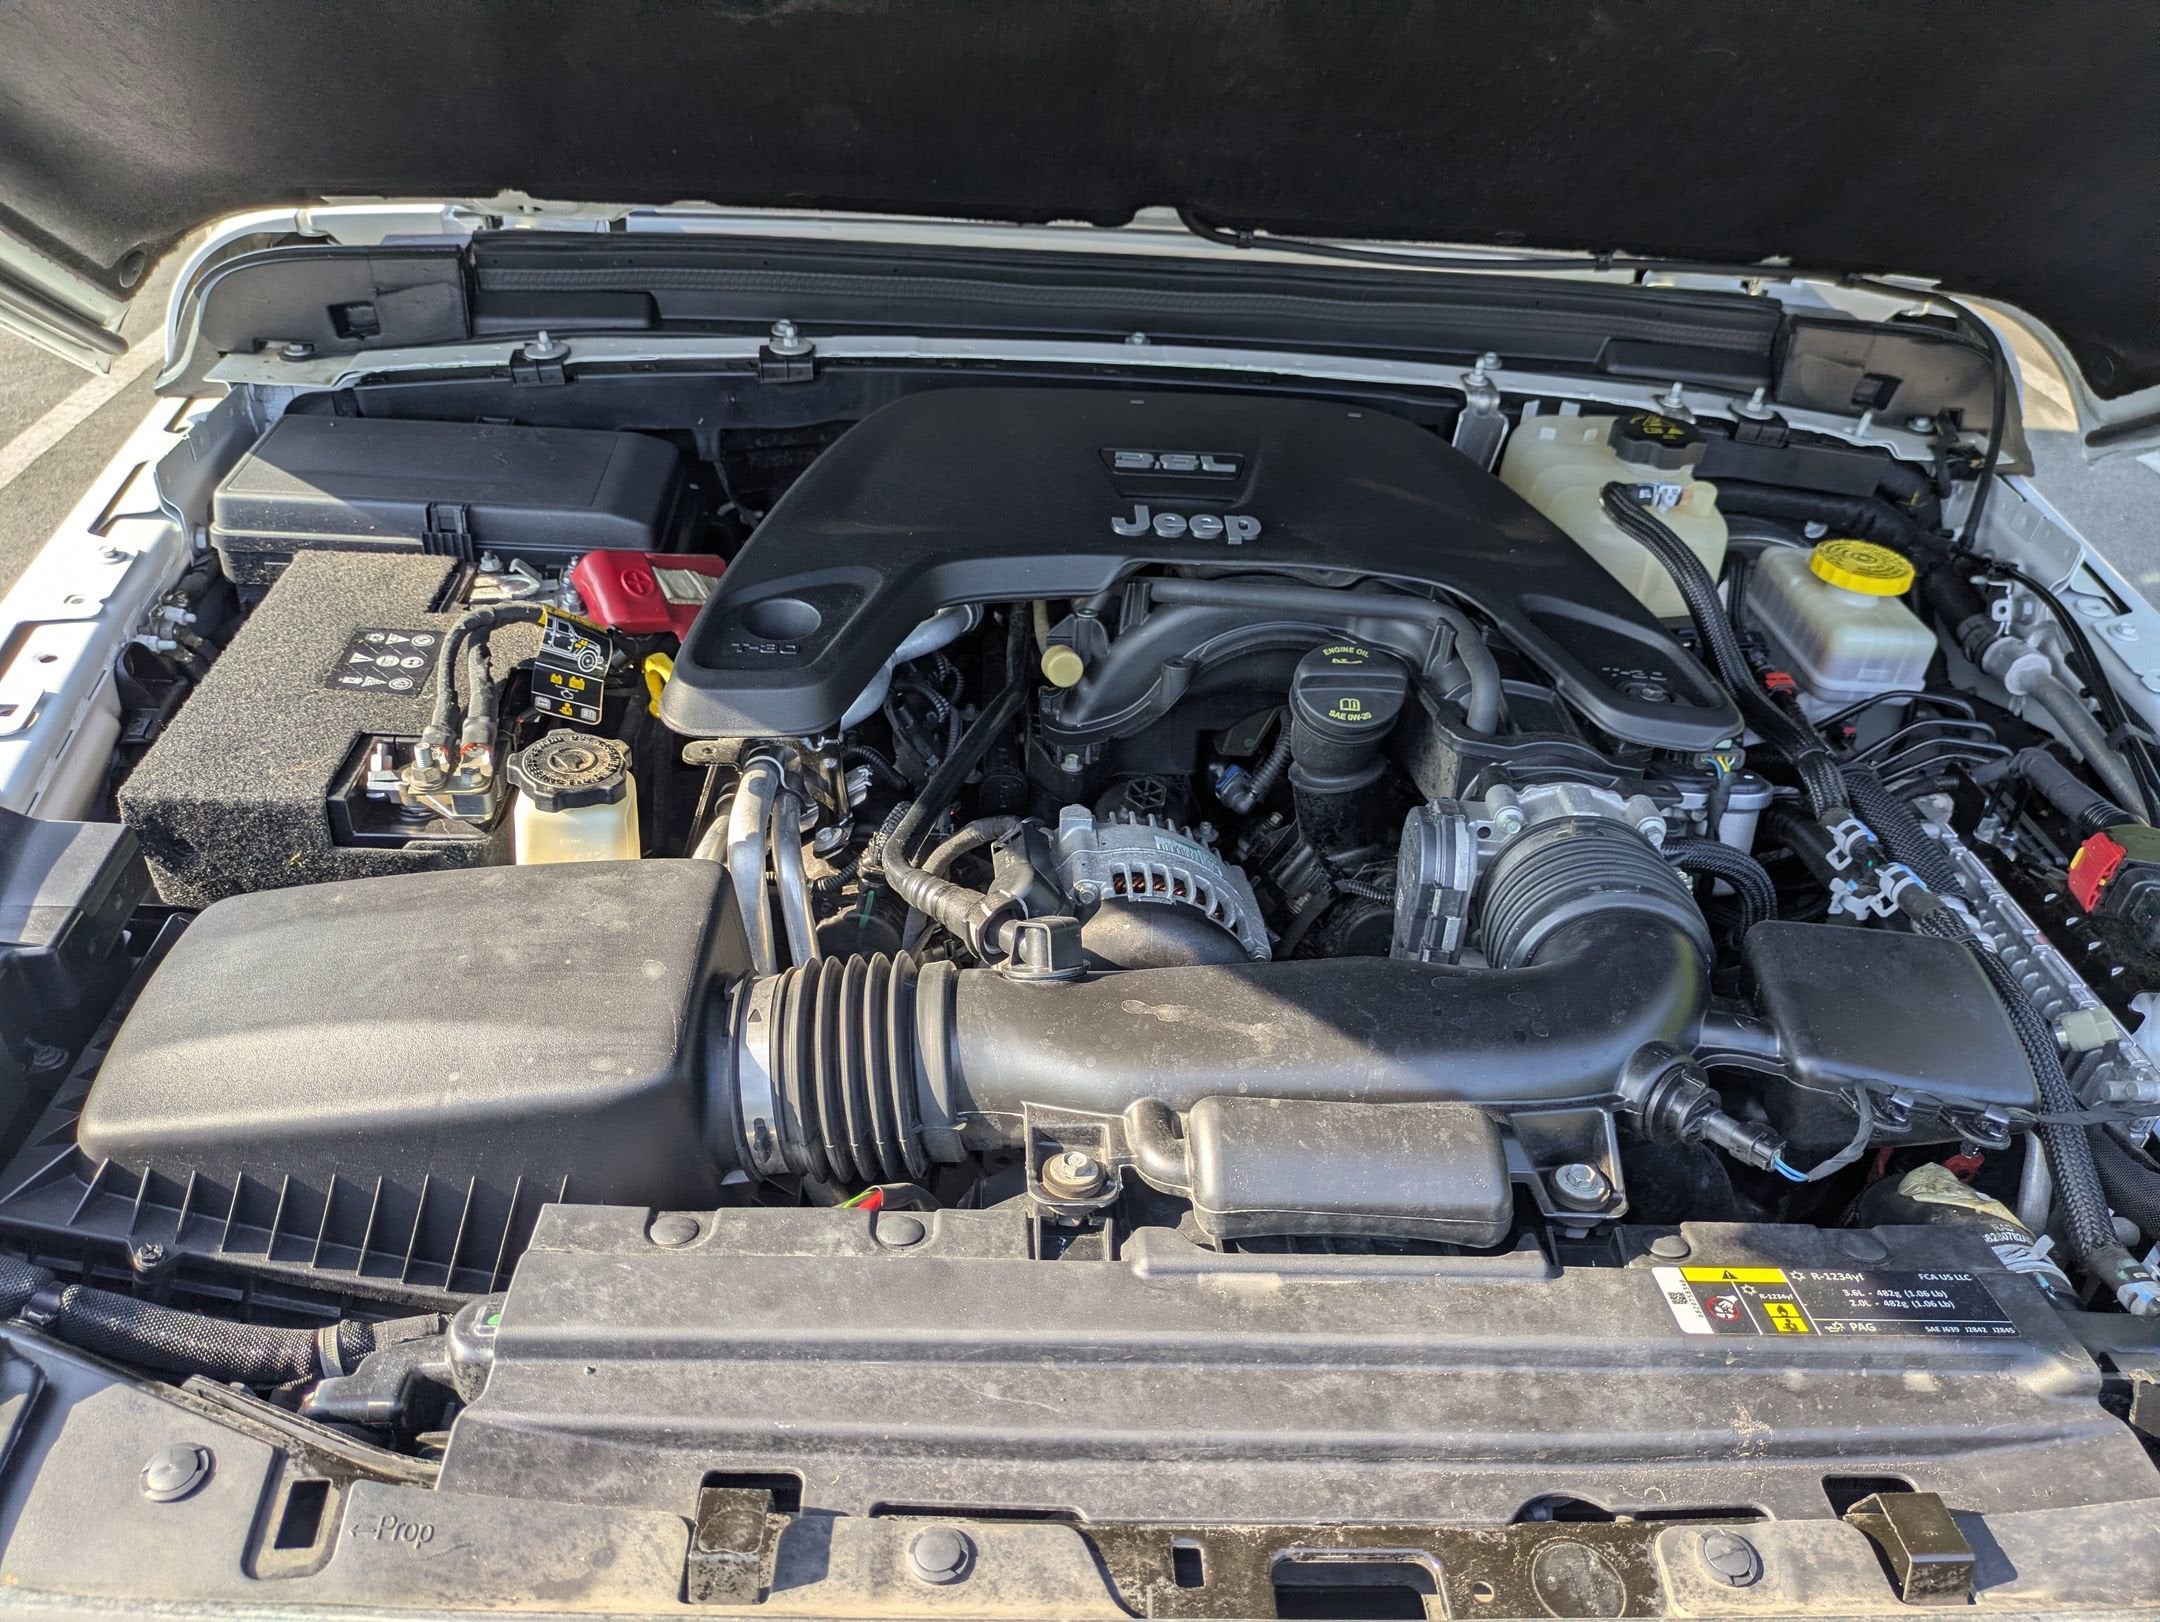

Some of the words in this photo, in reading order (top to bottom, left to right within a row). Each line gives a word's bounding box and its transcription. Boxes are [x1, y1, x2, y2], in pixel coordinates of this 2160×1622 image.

[1111, 504, 1262, 545] Jeep
[1322, 646, 1355, 656] ENGINE
[1355, 647, 1370, 658] OIL
[1328, 709, 1346, 721] SAE
[1347, 711, 1372, 721] 0W-20
[1991, 1223, 2014, 1232] RAD
[1810, 1271, 1865, 1283] R-1234yf
[1918, 1273, 1938, 1281] FCA
[1938, 1273, 1954, 1281] US
[1954, 1273, 1973, 1282] LLC
[1841, 1288, 1865, 1297] 3.6L
[1876, 1289, 1902, 1298] 482g
[1903, 1289, 1930, 1298] (1.06
[1930, 1289, 1949, 1299] Lb)
[1848, 1299, 1872, 1307] 2.0L
[1883, 1300, 1909, 1309] 482g
[1911, 1300, 1938, 1309] (1.06
[1938, 1300, 1956, 1310] Lb)
[1849, 1322, 1877, 1333] PAG
[374, 1514, 436, 1550] Prop
